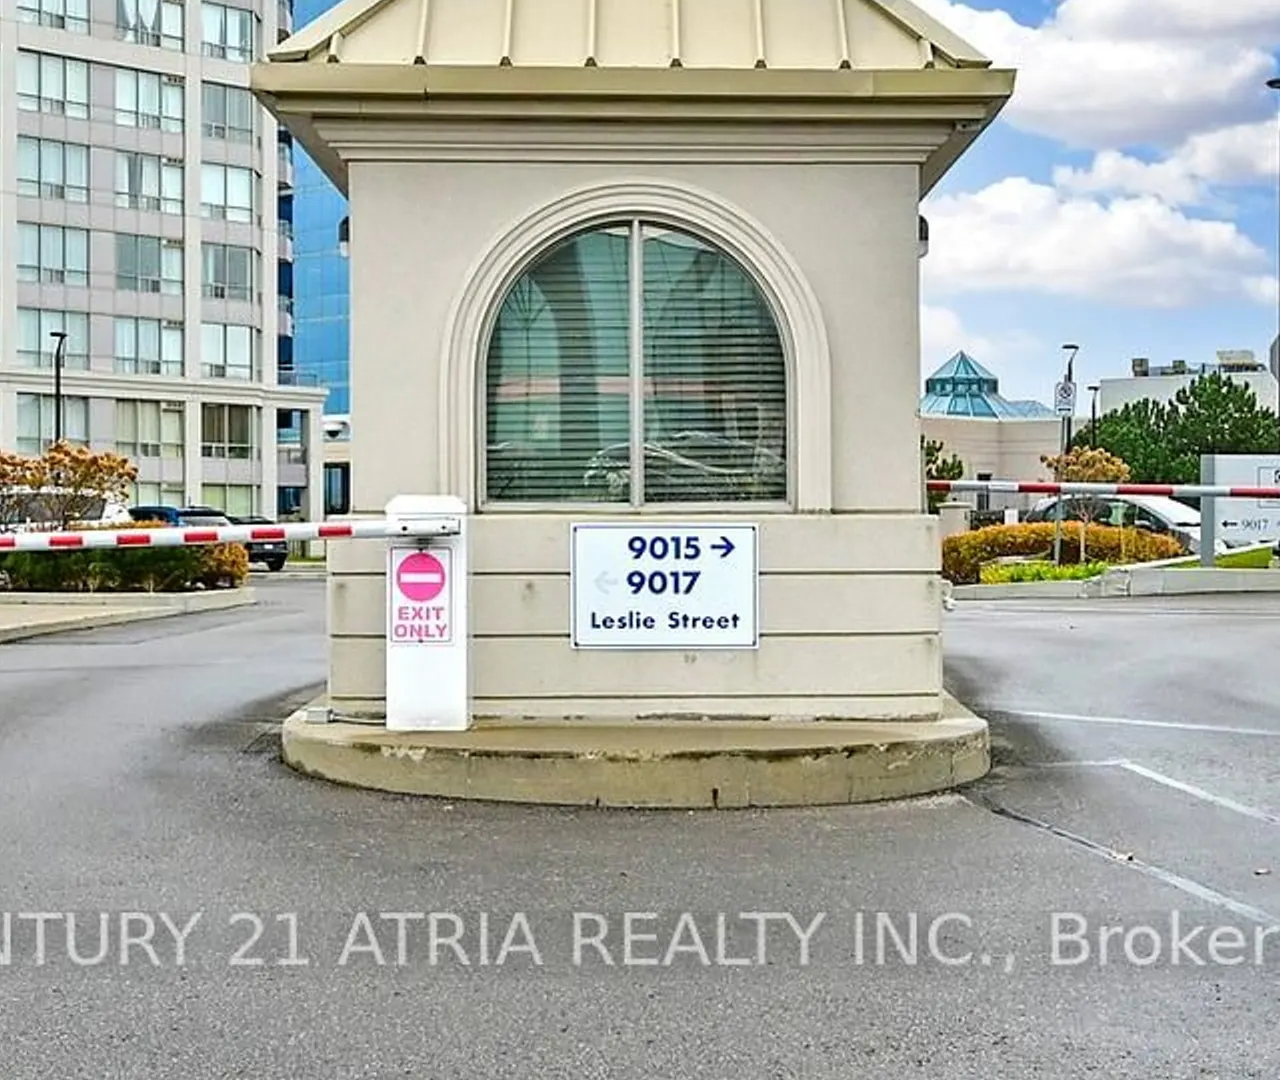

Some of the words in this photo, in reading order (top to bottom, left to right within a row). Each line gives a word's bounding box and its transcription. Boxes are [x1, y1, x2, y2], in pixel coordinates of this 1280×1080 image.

[1241, 520, 1269, 531] 9017
[628, 536, 701, 560] 9015
[626, 570, 701, 595] 9017
[398, 606, 445, 620] EXIT
[591, 611, 656, 629] Leslie
[668, 611, 740, 629] Street
[394, 623, 447, 638] ONLY
